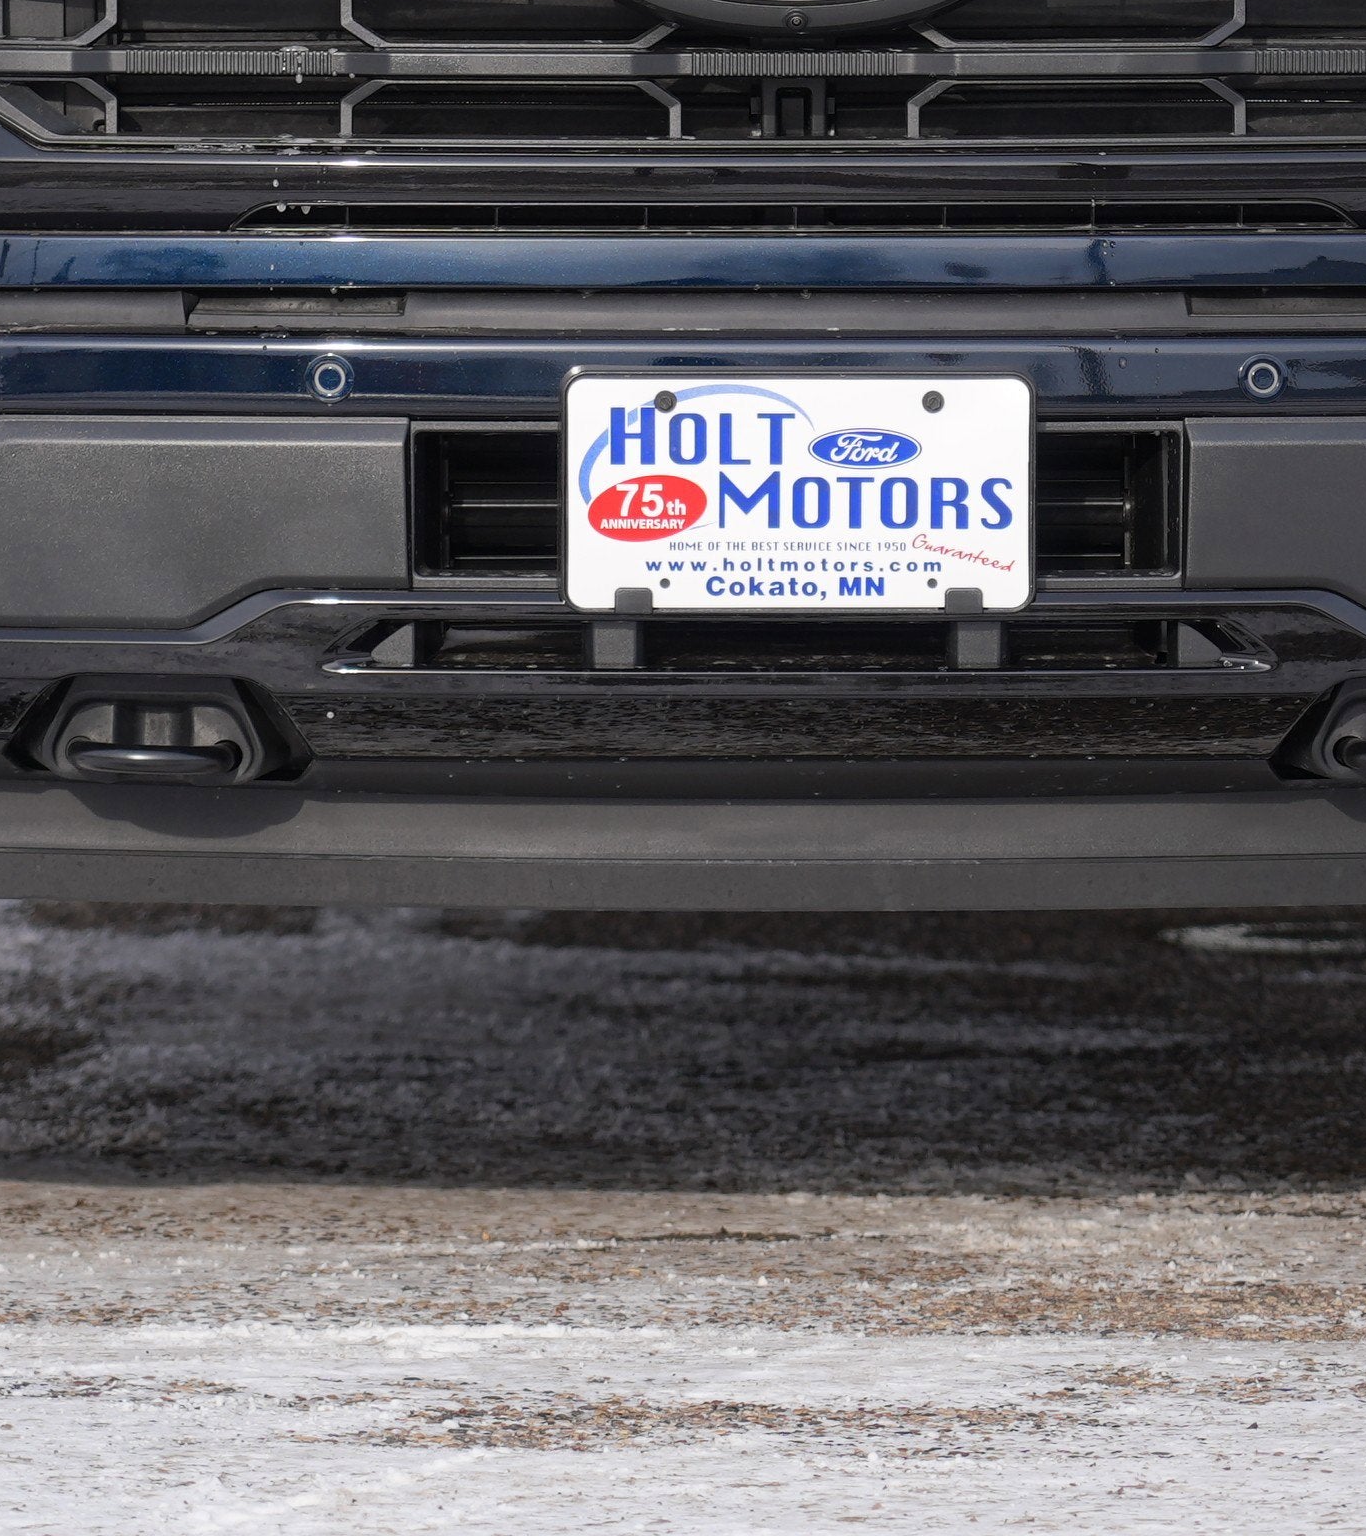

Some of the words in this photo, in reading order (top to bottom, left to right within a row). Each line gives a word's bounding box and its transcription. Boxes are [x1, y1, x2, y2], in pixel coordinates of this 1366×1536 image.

[610, 407, 795, 465] HOLT
[830, 433, 900, 463] Ford
[615, 482, 687, 518] 75th
[719, 471, 1013, 530] MOTORS
[600, 518, 686, 530] ANNIVERSARY
[669, 541, 702, 552] HOME
[708, 541, 721, 552] OF
[727, 541, 746, 552] THE
[751, 541, 778, 552] BEST
[783, 541, 832, 552] SERVICE
[836, 541, 872, 552] SINCE
[877, 541, 907, 552] 1950
[911, 533, 1018, 572] Guaranteed
[646, 558, 942, 572] www.holtmotors.com
[705, 576, 827, 600] Cokato,
[838, 576, 885, 596] MN
